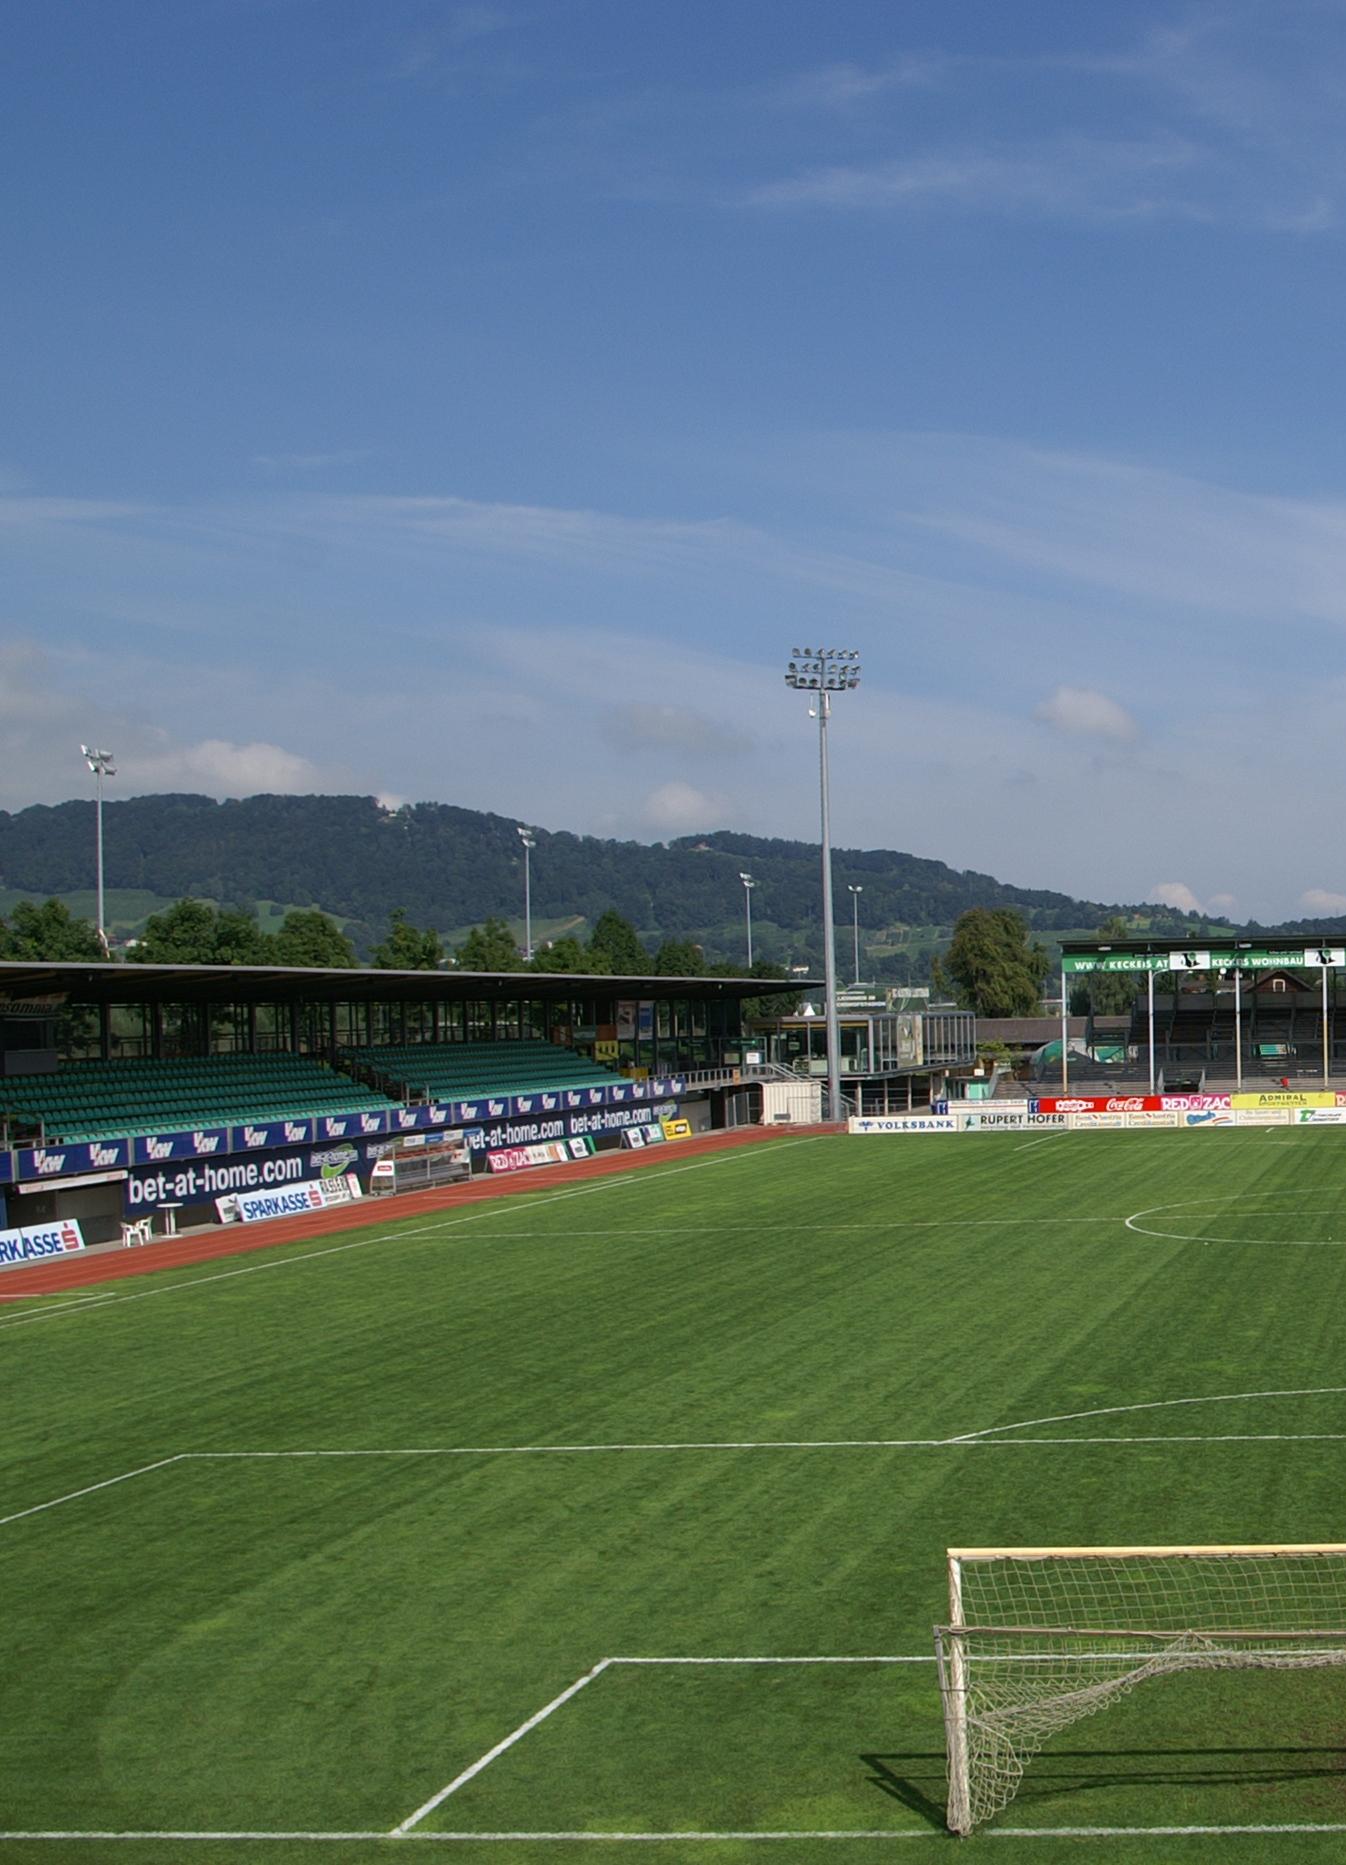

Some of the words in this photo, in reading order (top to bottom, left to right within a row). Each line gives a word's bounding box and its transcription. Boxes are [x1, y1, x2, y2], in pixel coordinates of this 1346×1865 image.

[1252, 956, 1303, 966] WOHNBAU
[1161, 1097, 1189, 1111] RED
[1203, 1096, 1231, 1110] ZAC
[1259, 1094, 1307, 1102] ADMIRAL
[571, 1106, 652, 1135] bet-at-home.com
[876, 1120, 955, 1130] VOLKSBANK
[980, 1115, 1024, 1125] RUPERT
[1027, 1114, 1065, 1124] HOFER
[129, 1157, 302, 1204] bet-at-home.com
[243, 1192, 310, 1221] SPARKASSE
